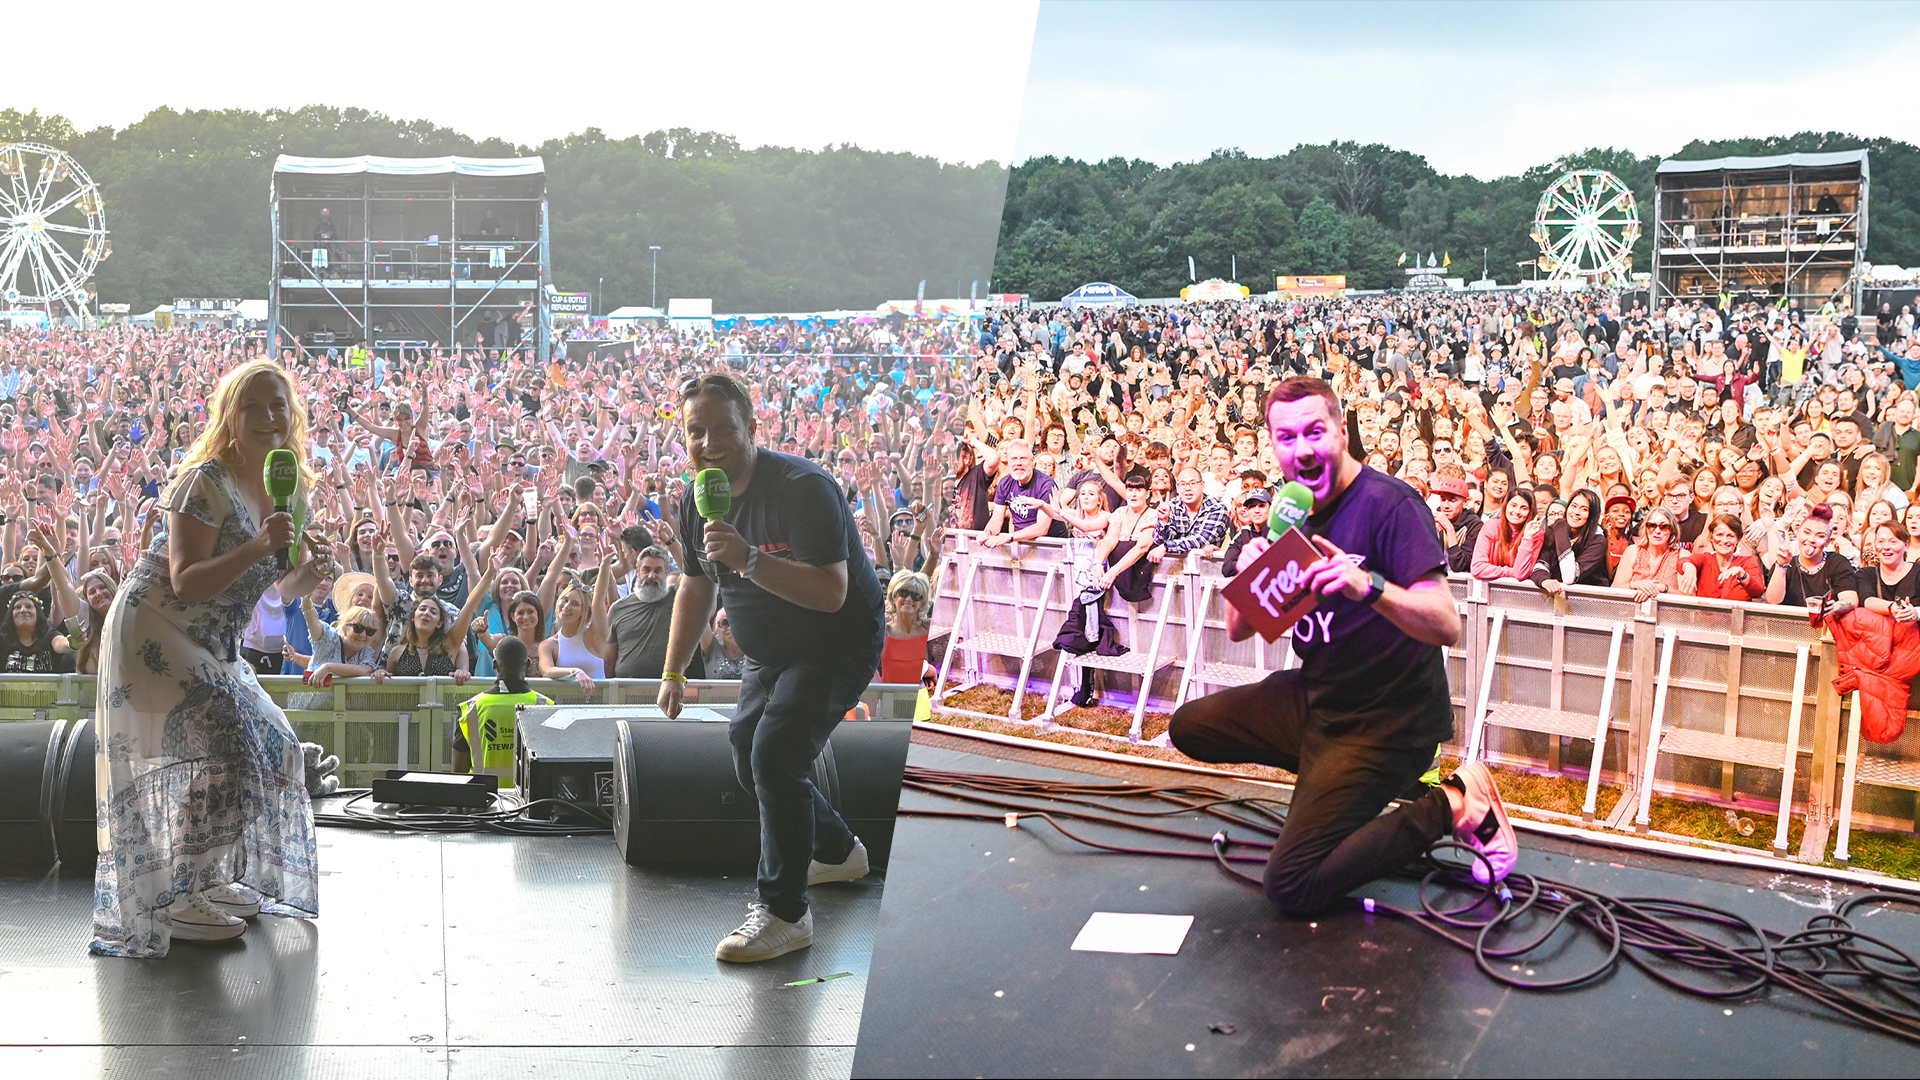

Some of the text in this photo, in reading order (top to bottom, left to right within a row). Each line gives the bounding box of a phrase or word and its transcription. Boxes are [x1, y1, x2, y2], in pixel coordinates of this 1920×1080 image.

[177, 300, 191, 309] BAR
[200, 300, 213, 309] BAR
[222, 300, 236, 309] BAR
[272, 461, 296, 478] Free
[707, 477, 730, 496] Free
[1275, 496, 1305, 520] Free
[1250, 560, 1304, 618] Free
